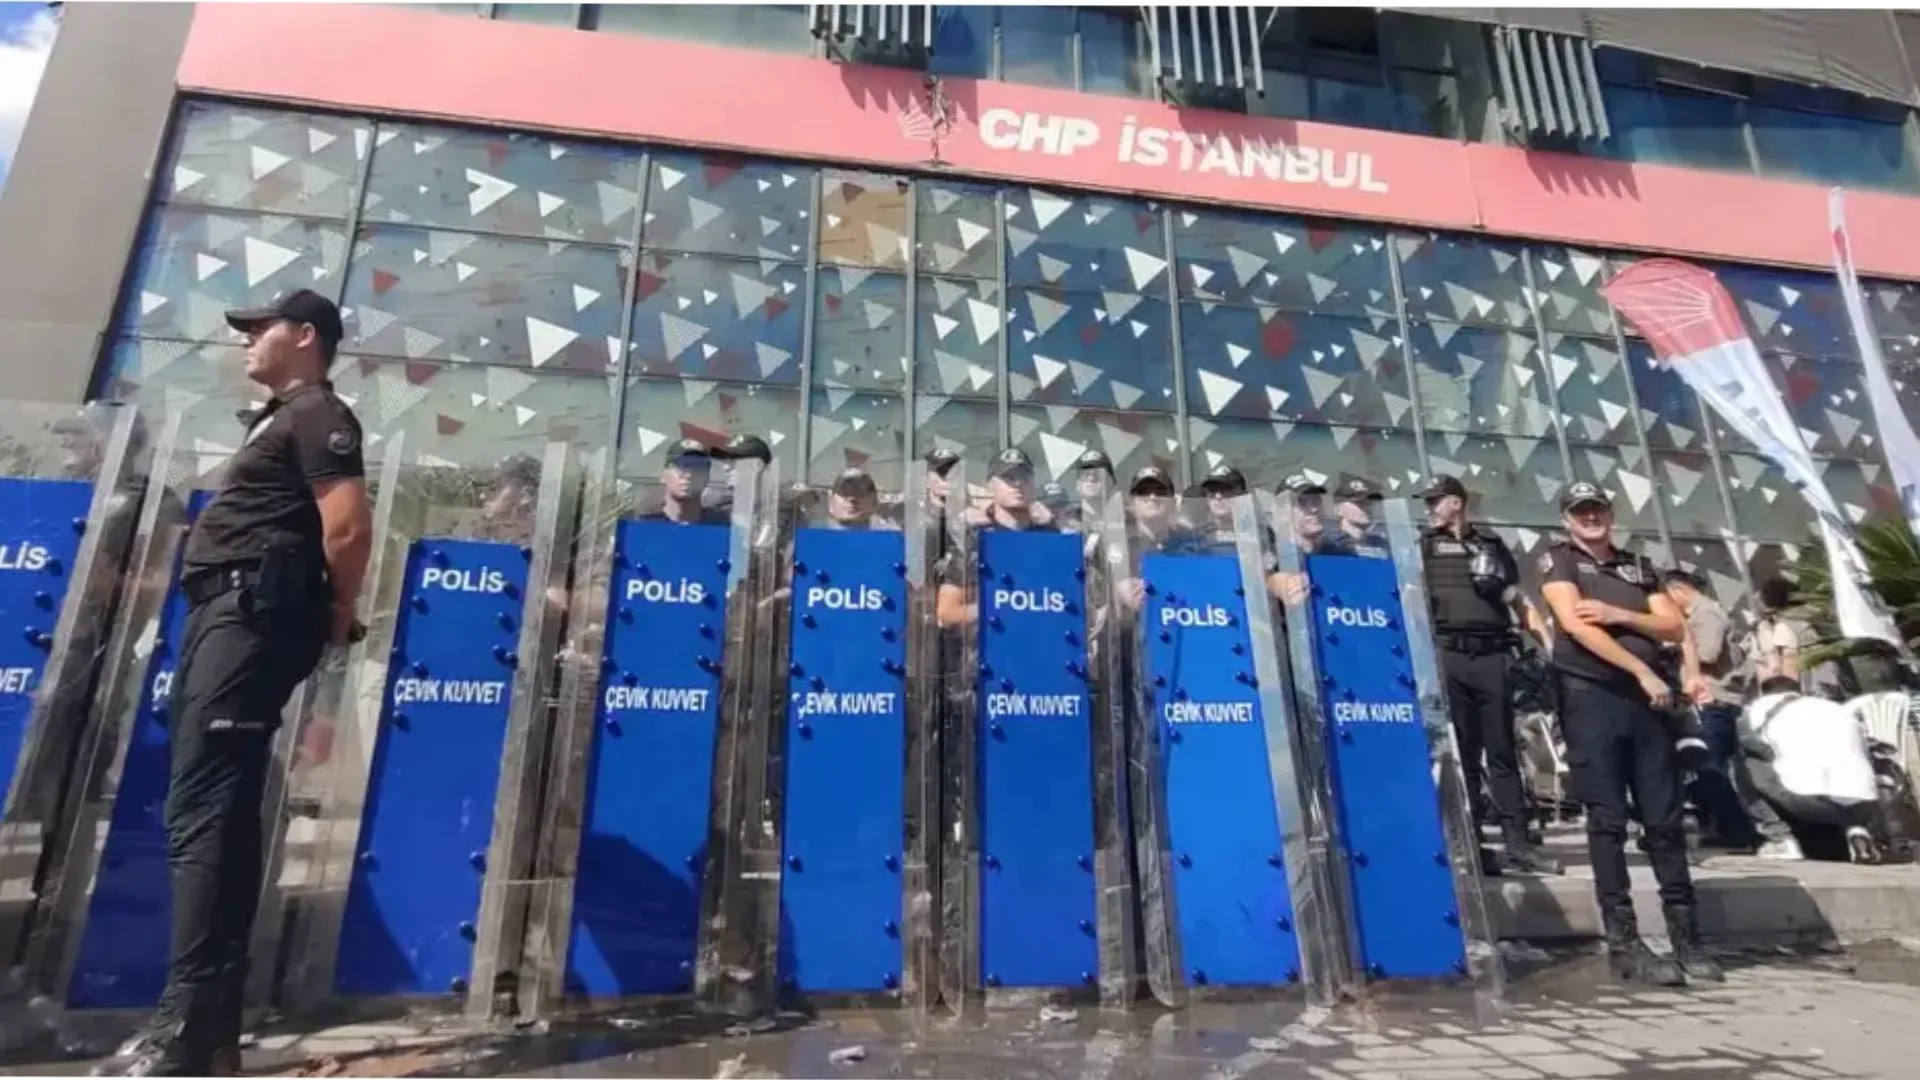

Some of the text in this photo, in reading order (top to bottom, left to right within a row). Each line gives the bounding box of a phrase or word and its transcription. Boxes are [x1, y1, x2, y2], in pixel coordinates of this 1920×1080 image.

[978, 108, 1389, 193] CHP İSTANBUL
[421, 567, 505, 593] POLİS
[626, 578, 704, 604] POLİS
[807, 584, 884, 610] POLİS
[994, 587, 1065, 612] POLİS
[1160, 604, 1231, 627] POLİS
[1326, 606, 1388, 628] POLİS
[442, 681, 505, 705] KUVVET
[651, 688, 709, 712] KUVVET
[840, 691, 896, 715] KUVVET
[1030, 694, 1080, 717] KUVVET
[1204, 702, 1253, 722] KUVVET
[1372, 703, 1414, 723] KUVVET
